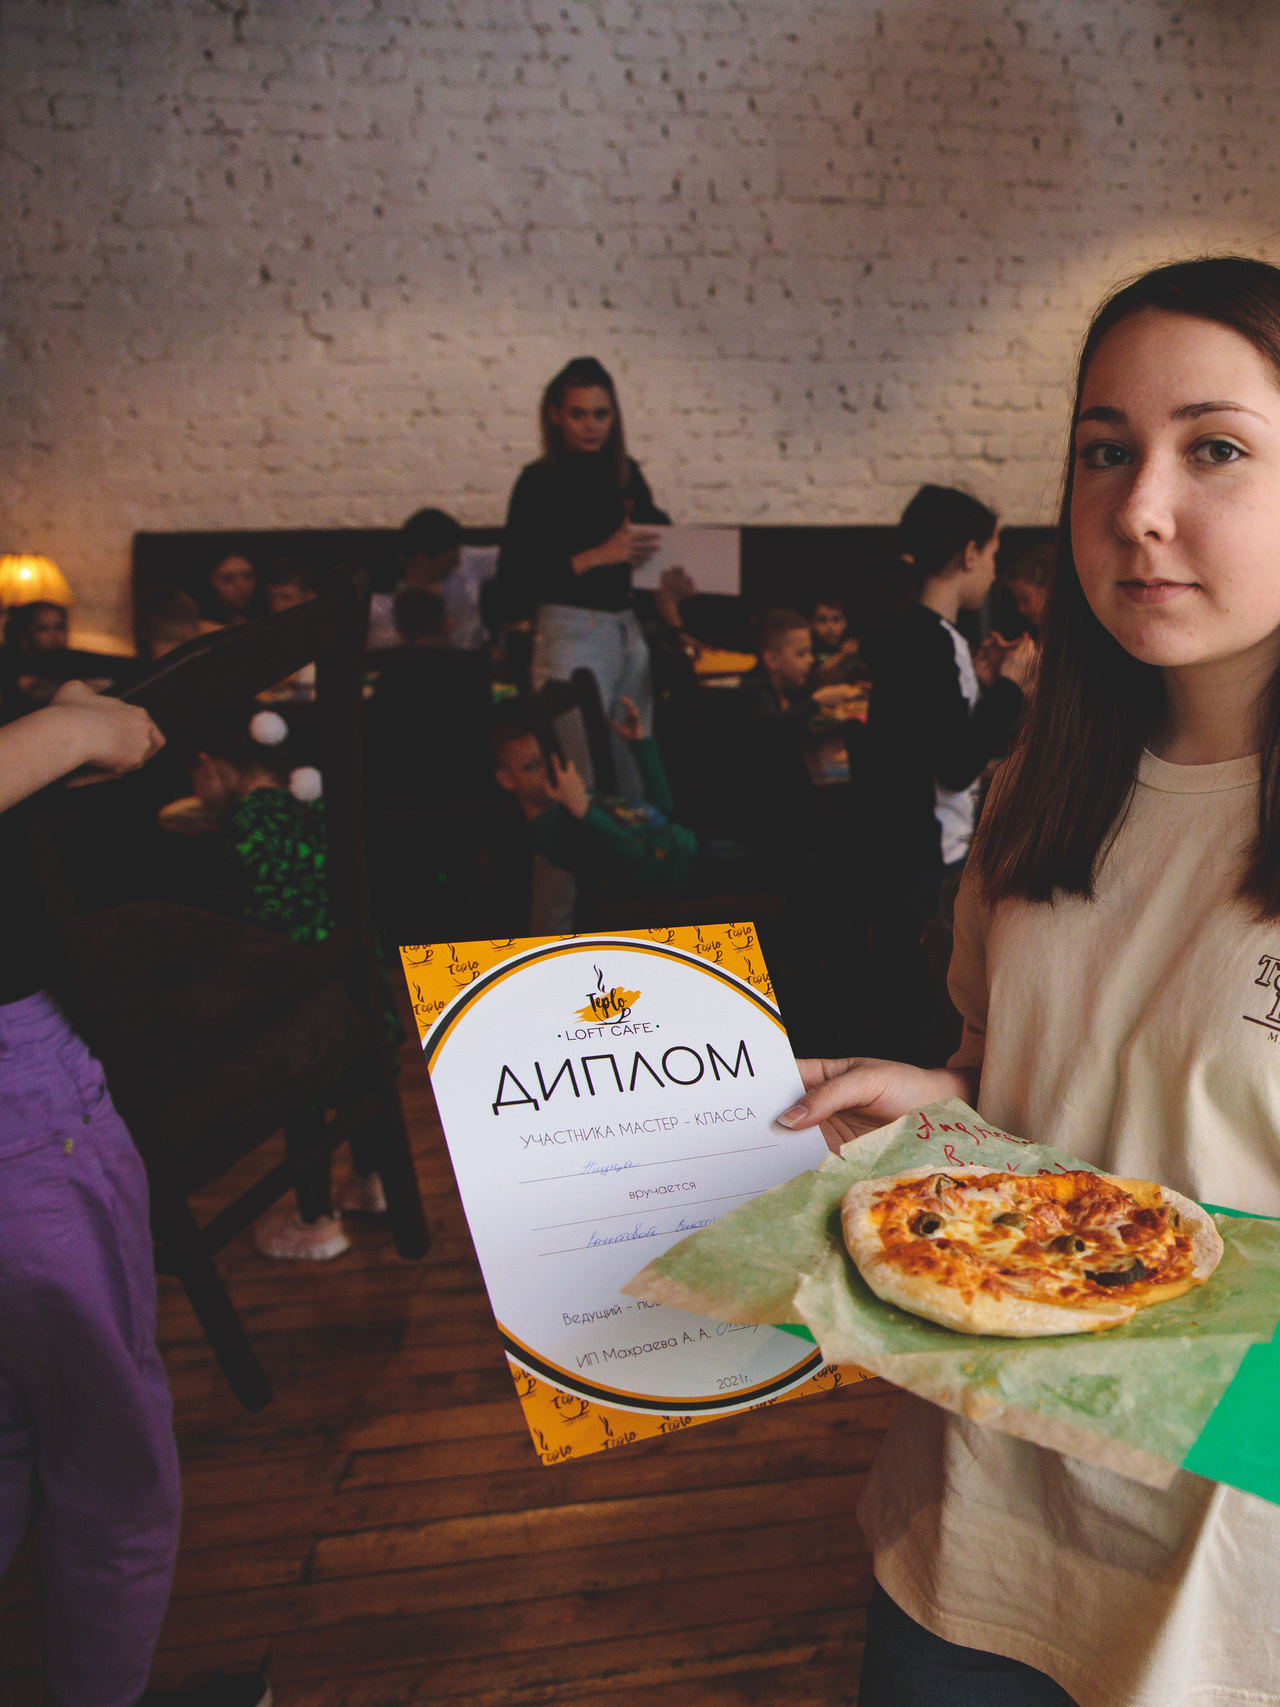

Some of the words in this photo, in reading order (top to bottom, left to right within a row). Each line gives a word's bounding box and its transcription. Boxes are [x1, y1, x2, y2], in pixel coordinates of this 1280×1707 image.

[586, 988, 627, 1019] Teplo
[565, 1026, 605, 1041] LOFT
[610, 1022, 653, 1036] CAFE
[491, 1039, 755, 1116] ДИПЛОМ
[519, 1125, 615, 1149] УЧАСТНИКА
[619, 1116, 679, 1136] МАСТЕР
[694, 1106, 757, 1126] КЛАССА
[628, 1181, 697, 1200] вручается
[562, 1304, 622, 1326] Ведущий
[575, 1351, 600, 1368] ИП
[603, 1336, 678, 1362] Махраева
